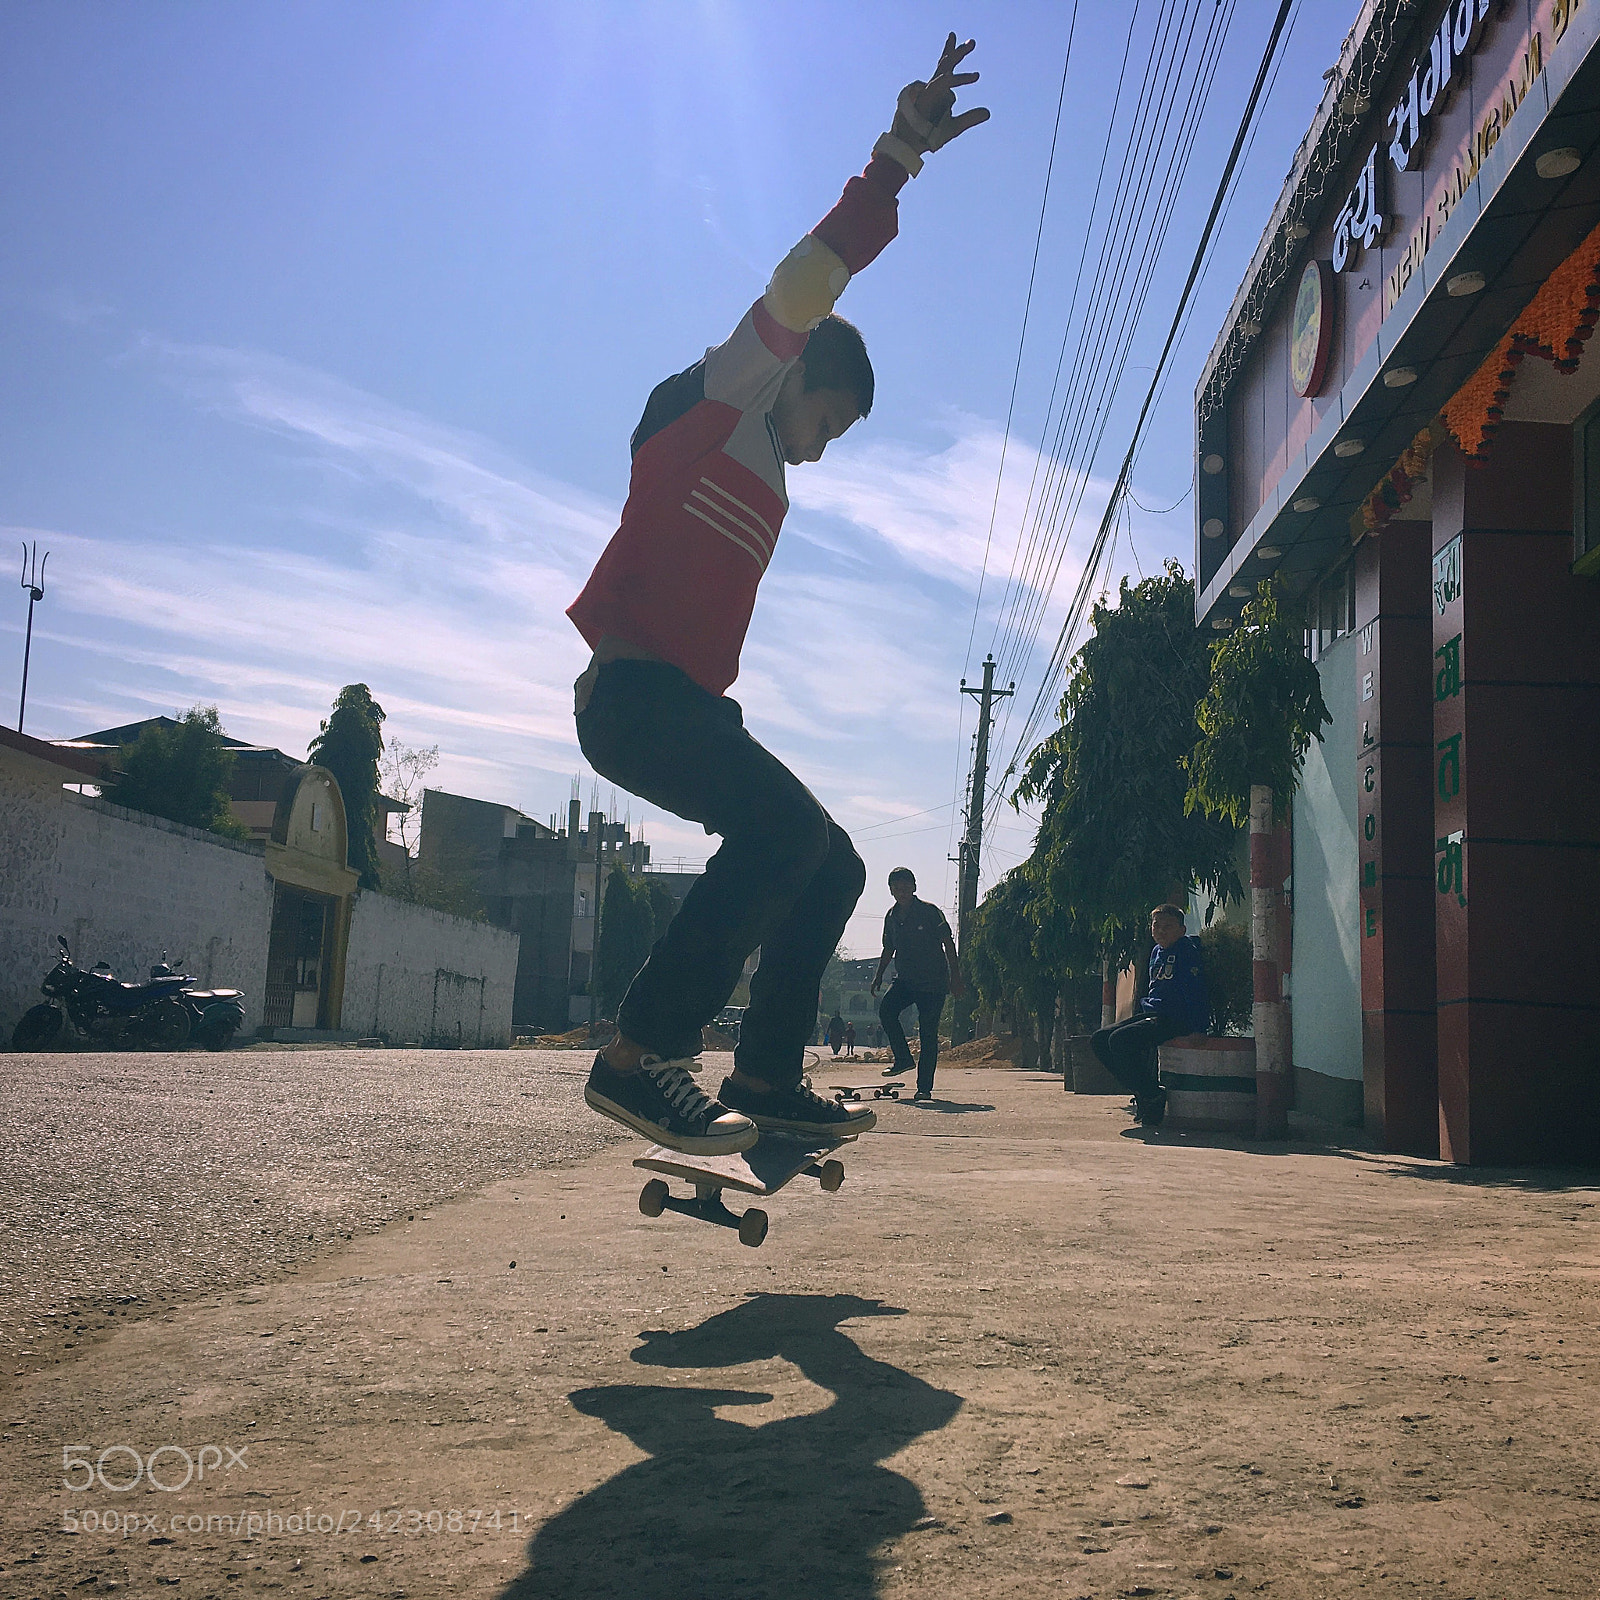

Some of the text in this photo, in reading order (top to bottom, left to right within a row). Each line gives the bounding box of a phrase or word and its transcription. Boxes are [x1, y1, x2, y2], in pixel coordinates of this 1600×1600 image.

[1333, 142, 1383, 273] न्यू
[1387, 31, 1542, 312] NEW SANGAM
[1361, 621, 1377, 939] WELCOME
[1432, 534, 1468, 908] स्वागतम्
